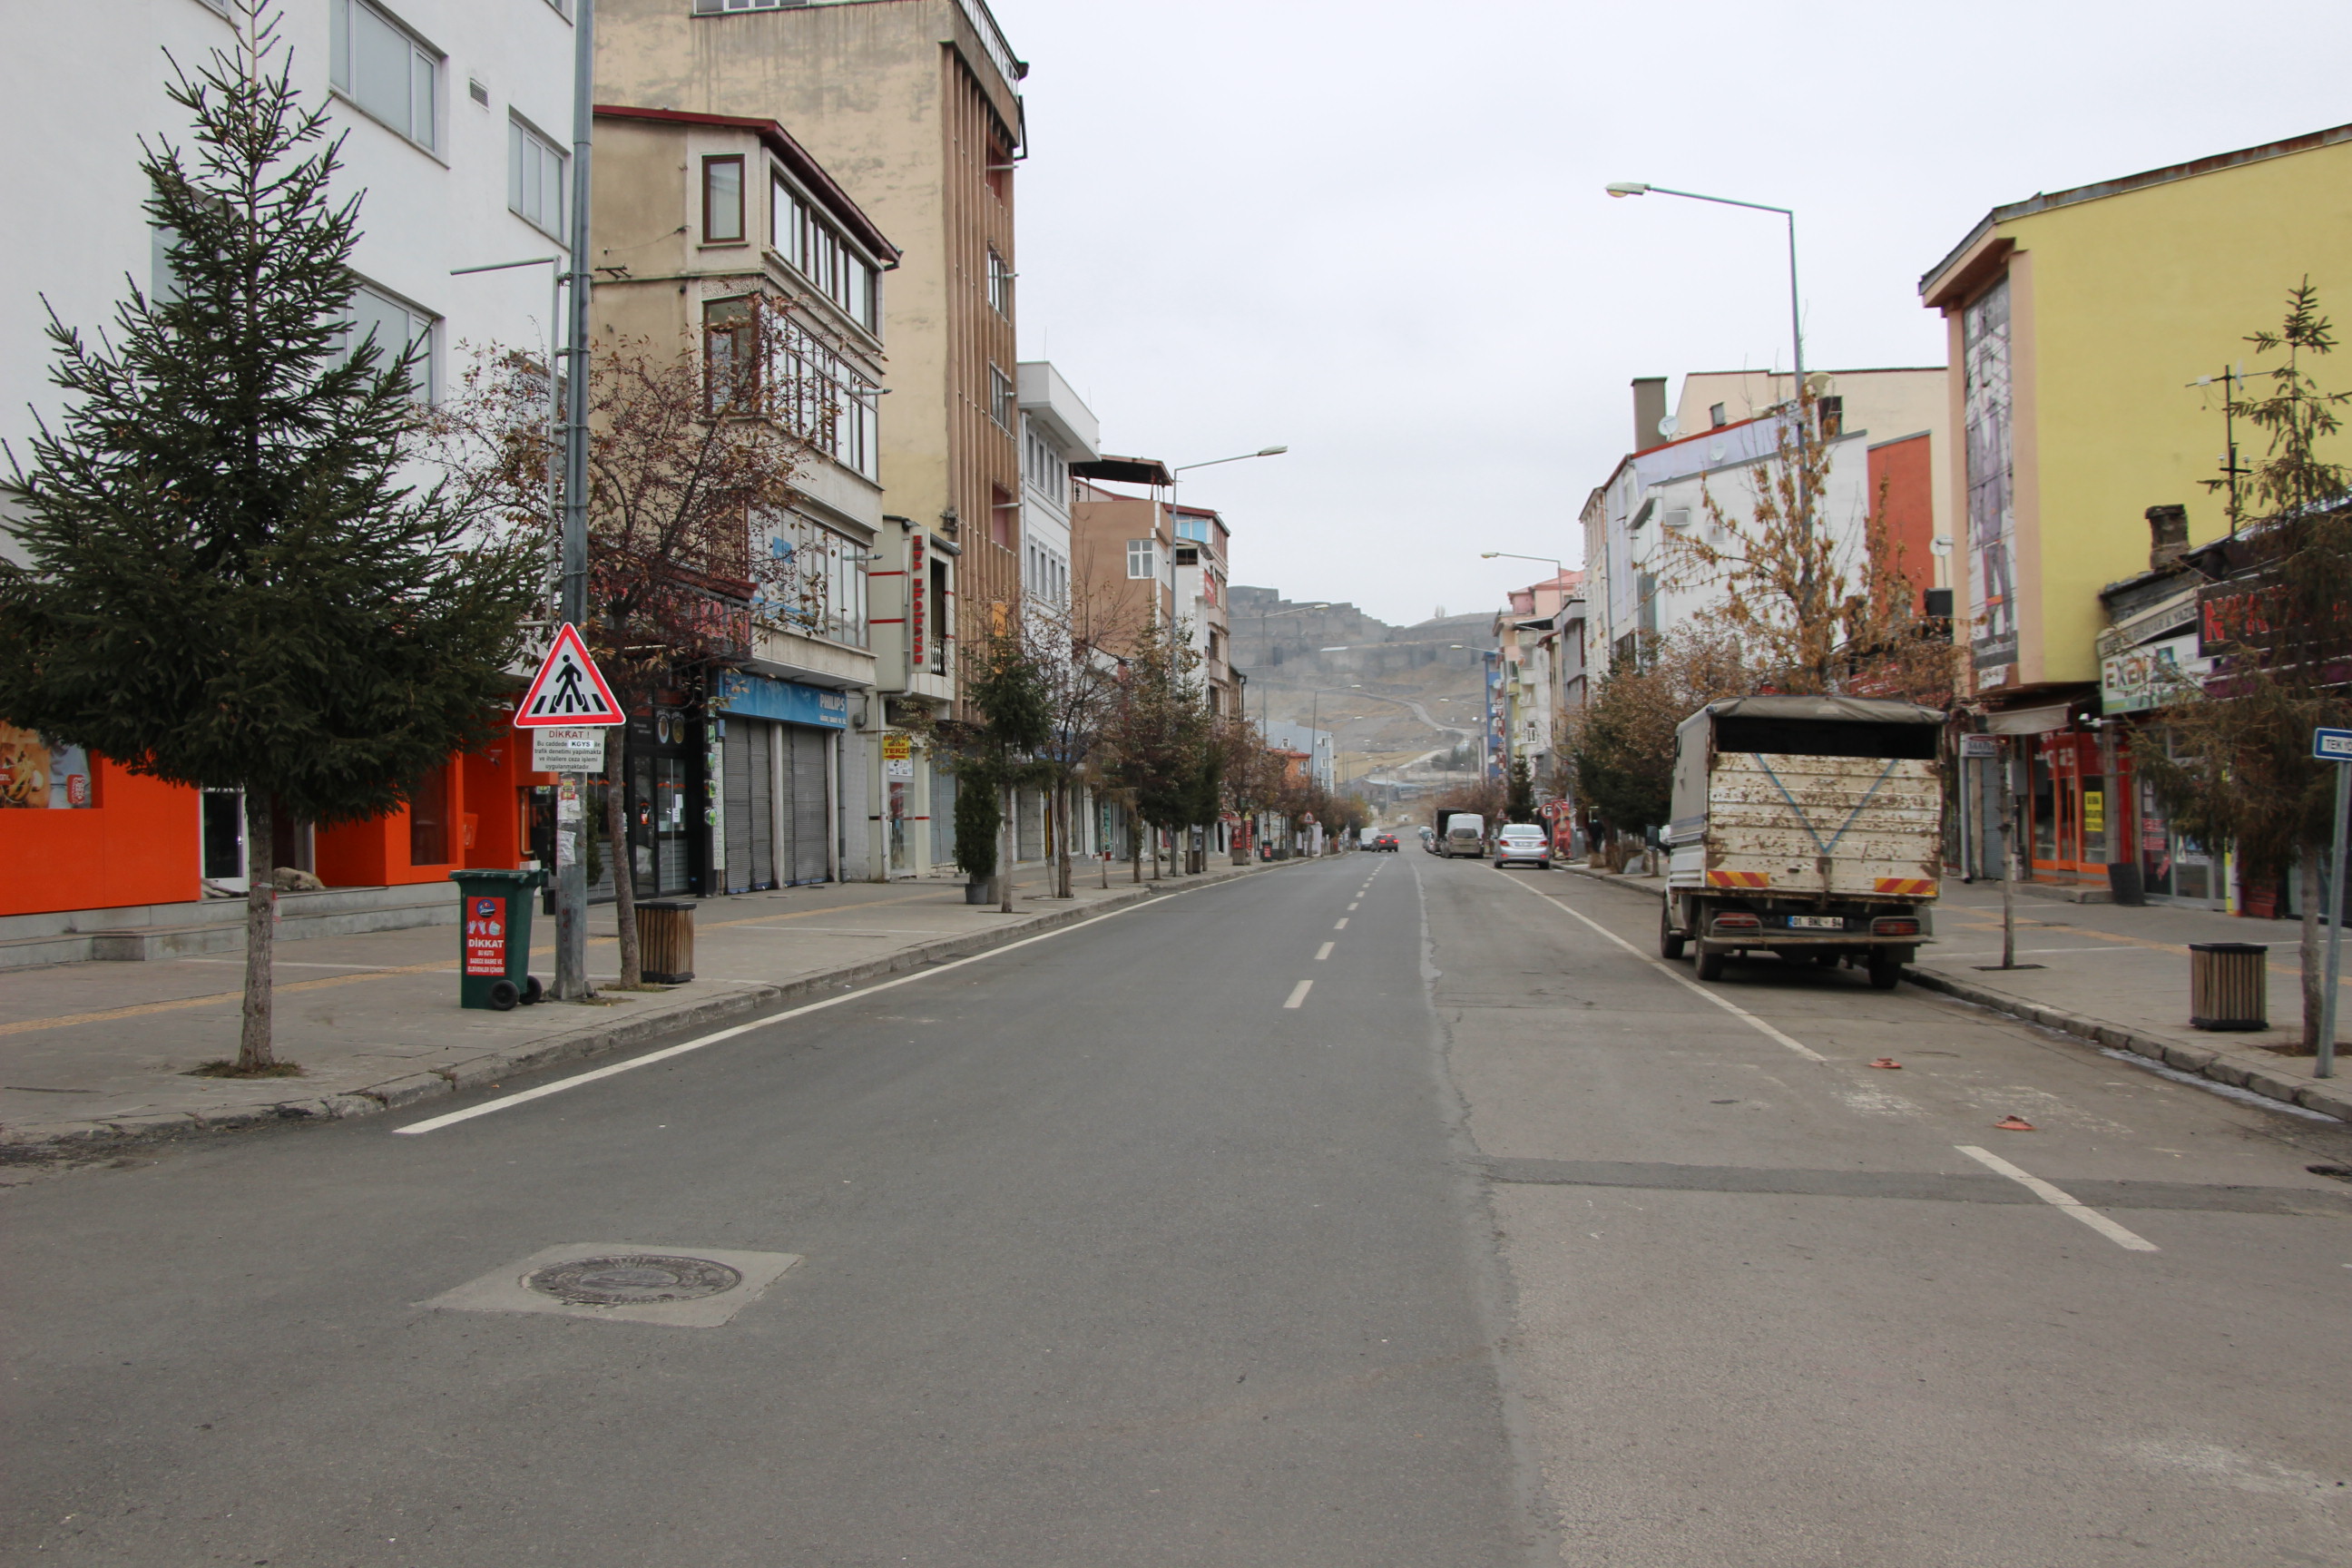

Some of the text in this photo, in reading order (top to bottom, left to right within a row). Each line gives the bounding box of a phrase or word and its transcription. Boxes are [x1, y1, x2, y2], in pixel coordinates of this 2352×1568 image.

[913, 578, 925, 664] BİLGİSAYAR
[819, 692, 846, 711] PHILIPS
[548, 730, 583, 738] DİKKAT
[2326, 739, 2341, 750] TEK
[468, 937, 504, 948] DİKKAT
